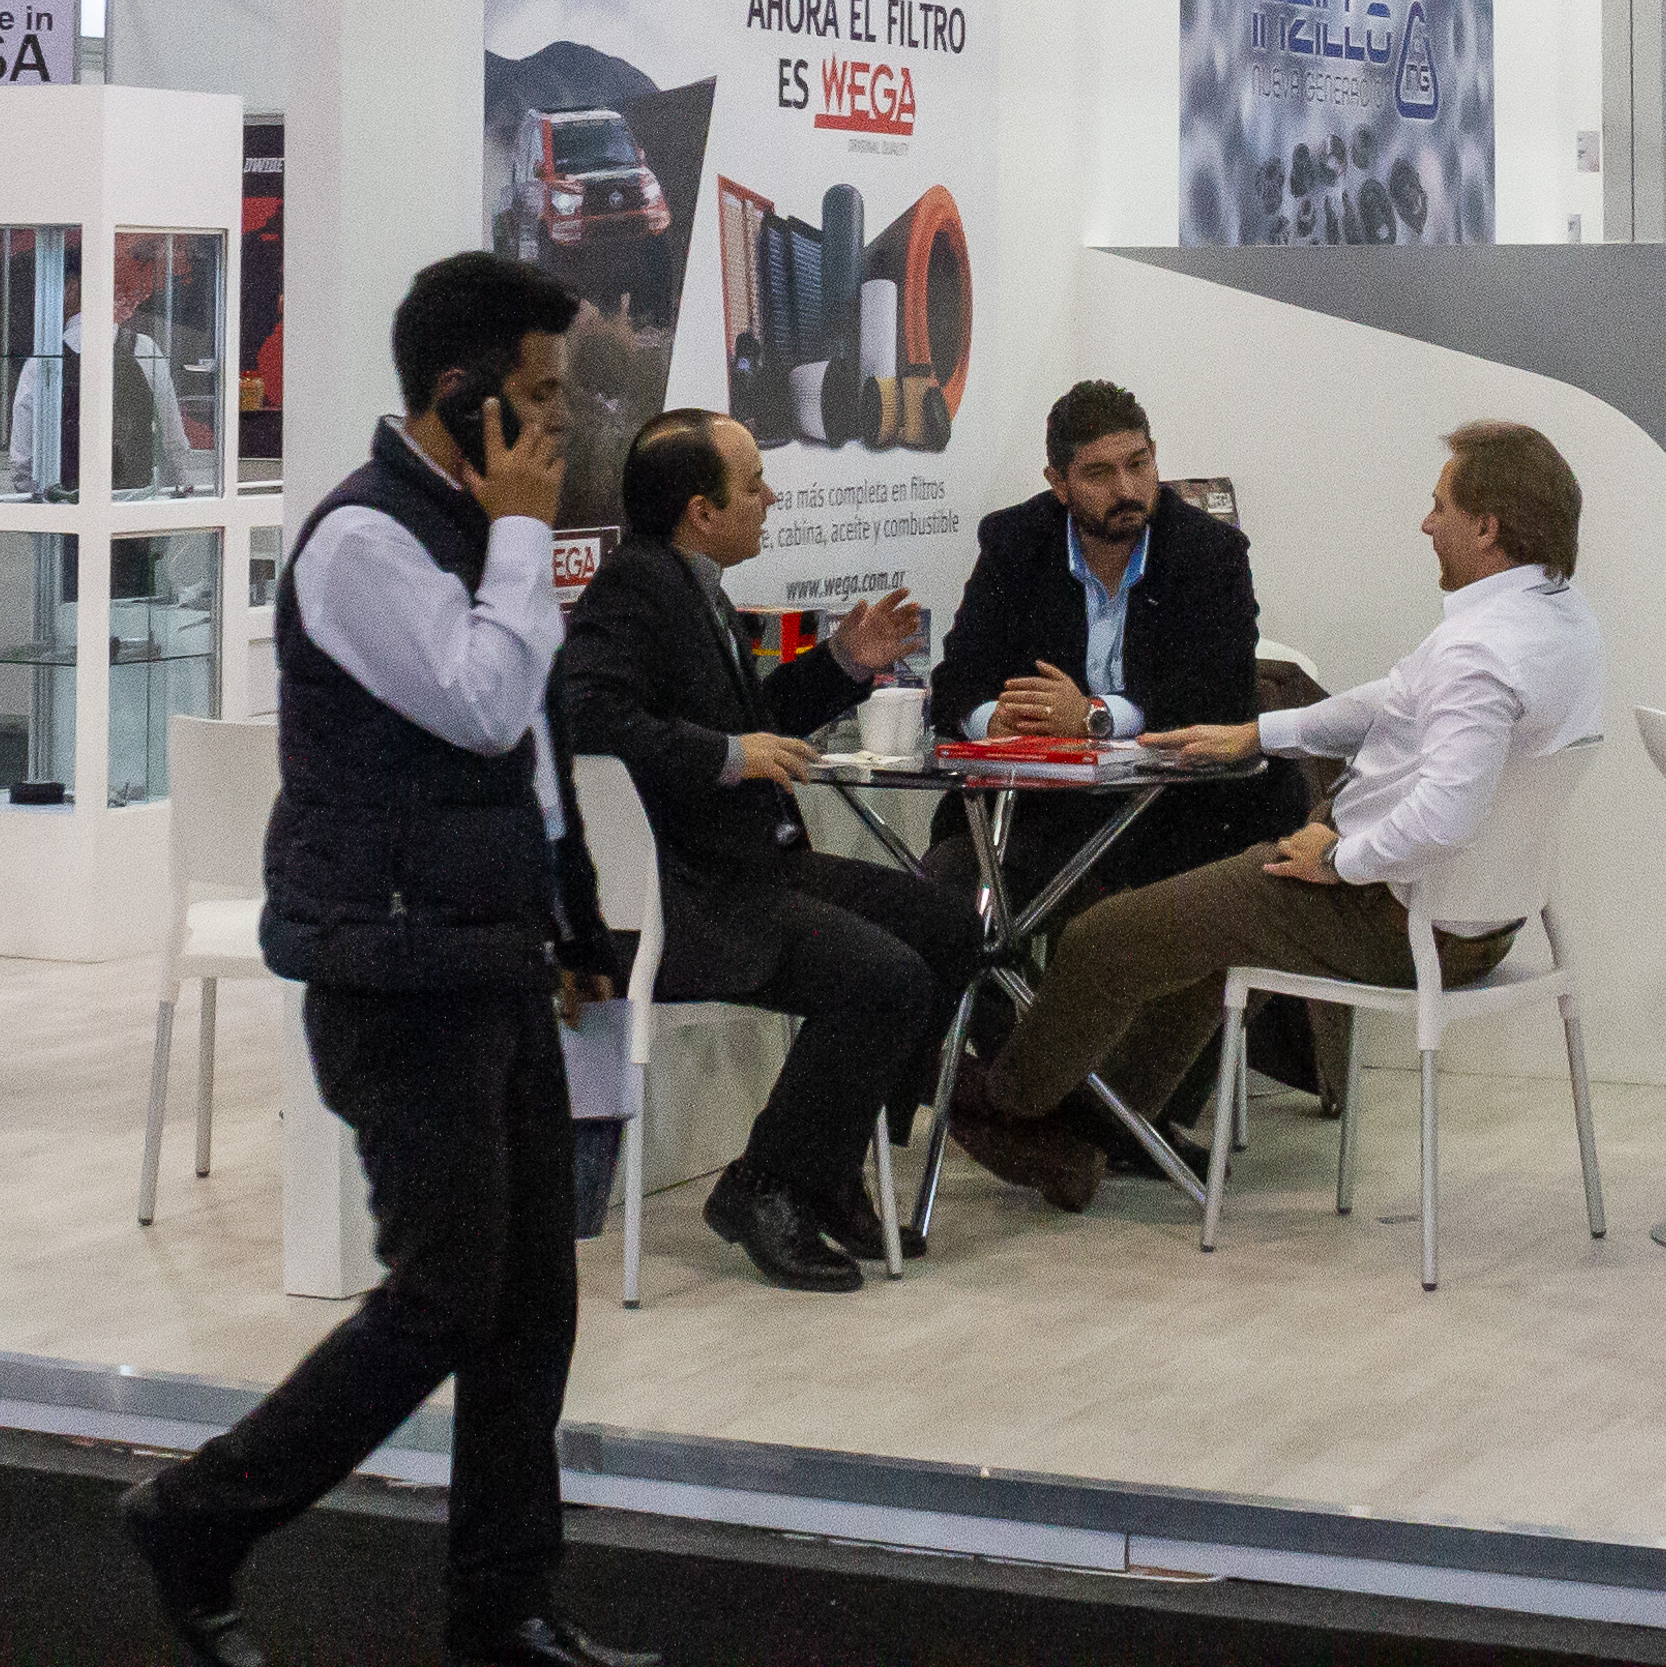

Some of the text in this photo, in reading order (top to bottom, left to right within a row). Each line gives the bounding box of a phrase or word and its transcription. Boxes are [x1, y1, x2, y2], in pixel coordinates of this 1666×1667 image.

[26, 5, 53, 31] in
[778, 52, 916, 133] ES WEGA
[796, 481, 824, 510] más
[828, 478, 887, 511] completa
[891, 484, 907, 503] en
[910, 475, 946, 501] filtros
[777, 518, 828, 548] cabina,
[831, 514, 870, 544] aceite
[873, 521, 882, 546] y
[883, 509, 960, 539] combustible
[552, 545, 596, 588] EGA
[785, 569, 907, 602] www.wega.com.ar
